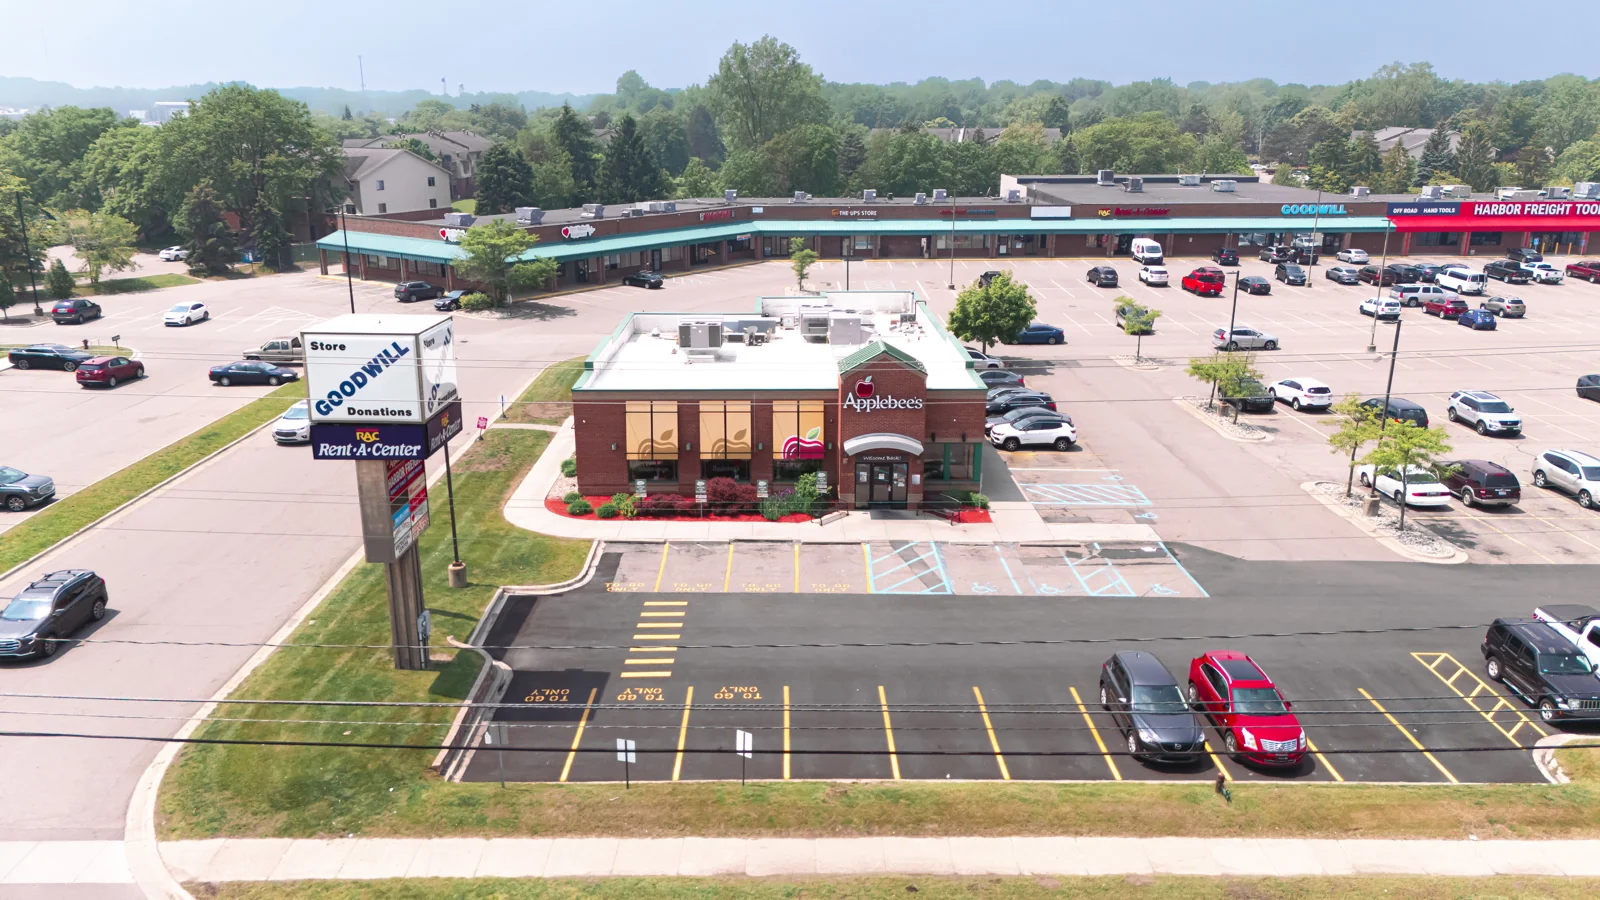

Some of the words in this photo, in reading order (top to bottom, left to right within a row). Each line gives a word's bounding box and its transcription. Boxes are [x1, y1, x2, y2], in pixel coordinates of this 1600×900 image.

[1098, 209, 1111, 217] RAC
[1281, 203, 1347, 215] GOODWILL
[1474, 203, 1521, 215] HARBOR
[1524, 203, 1572, 215] FREIGHT
[310, 341, 346, 351] Store
[315, 341, 410, 416] GOODWILL
[843, 391, 923, 412] Applebee's
[347, 406, 412, 417] Donations
[355, 431, 380, 443] RAC
[531, 688, 570, 696] ONLY
[714, 692, 734, 700] GO
[743, 692, 762, 700] TO
